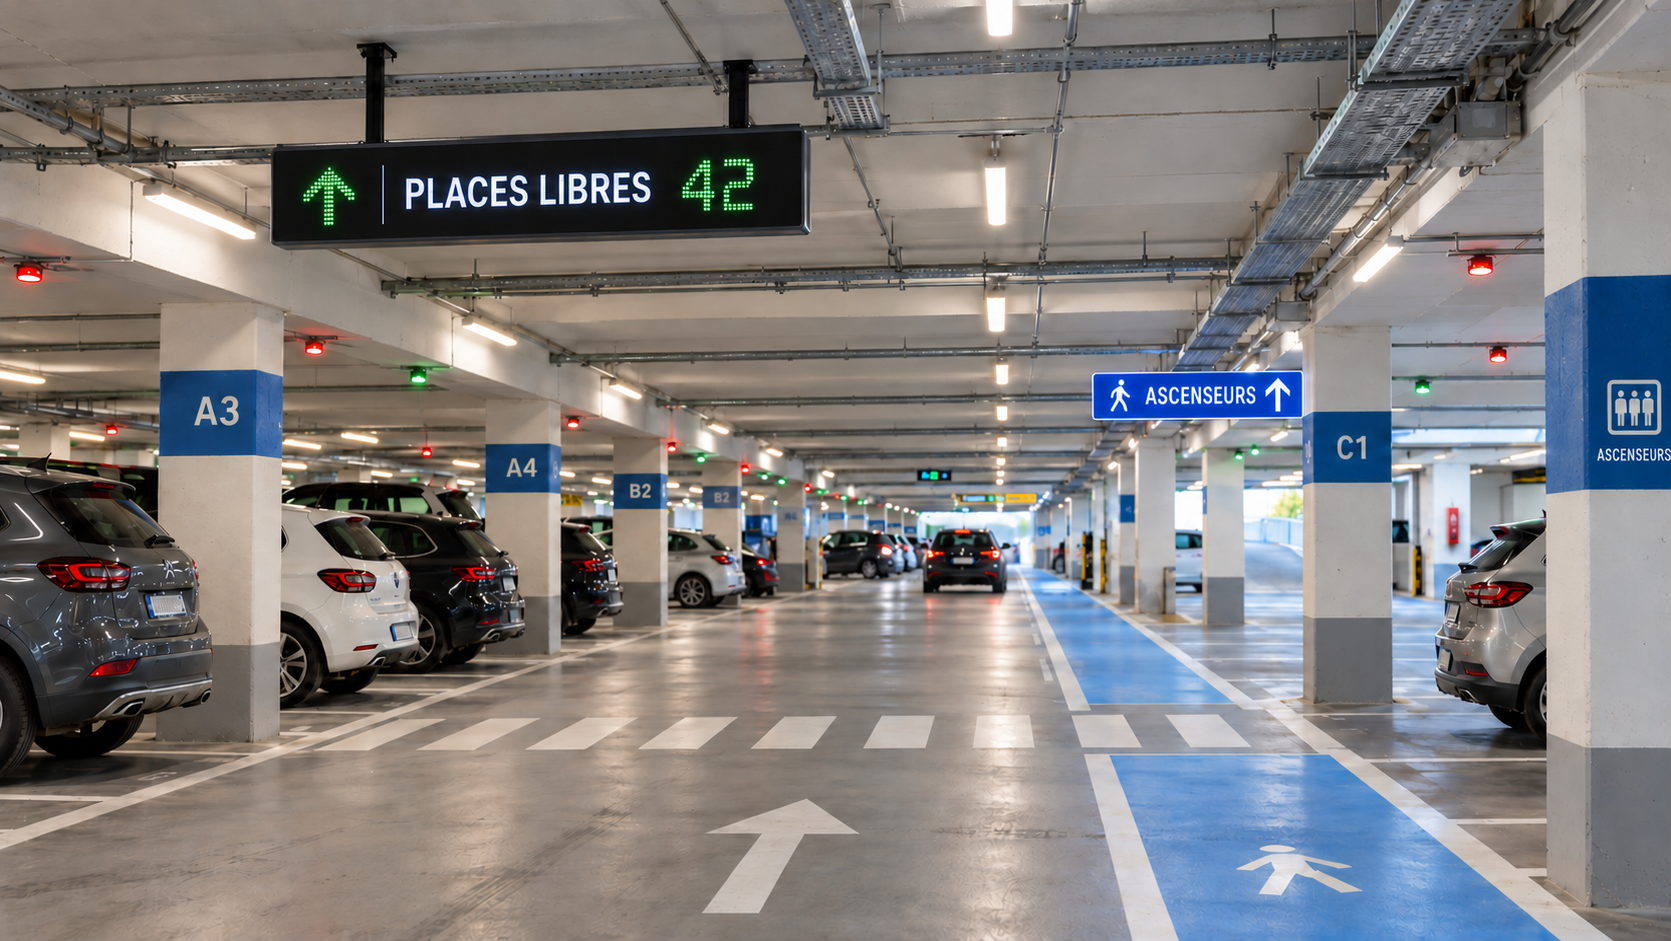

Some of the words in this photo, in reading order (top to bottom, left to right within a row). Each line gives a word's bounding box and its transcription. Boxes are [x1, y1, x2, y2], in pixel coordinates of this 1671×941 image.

[405, 174, 529, 210] PLACES
[540, 170, 651, 206] LIBRES
[681, 157, 755, 212] 42
[1146, 386, 1256, 406] ASCENSEURS
[193, 395, 240, 426] A3
[1337, 435, 1367, 460] C1
[1596, 447, 1671, 462] ASCENSEURS
[506, 457, 538, 478] A4
[629, 483, 652, 499] B2
[713, 491, 730, 504] B2
